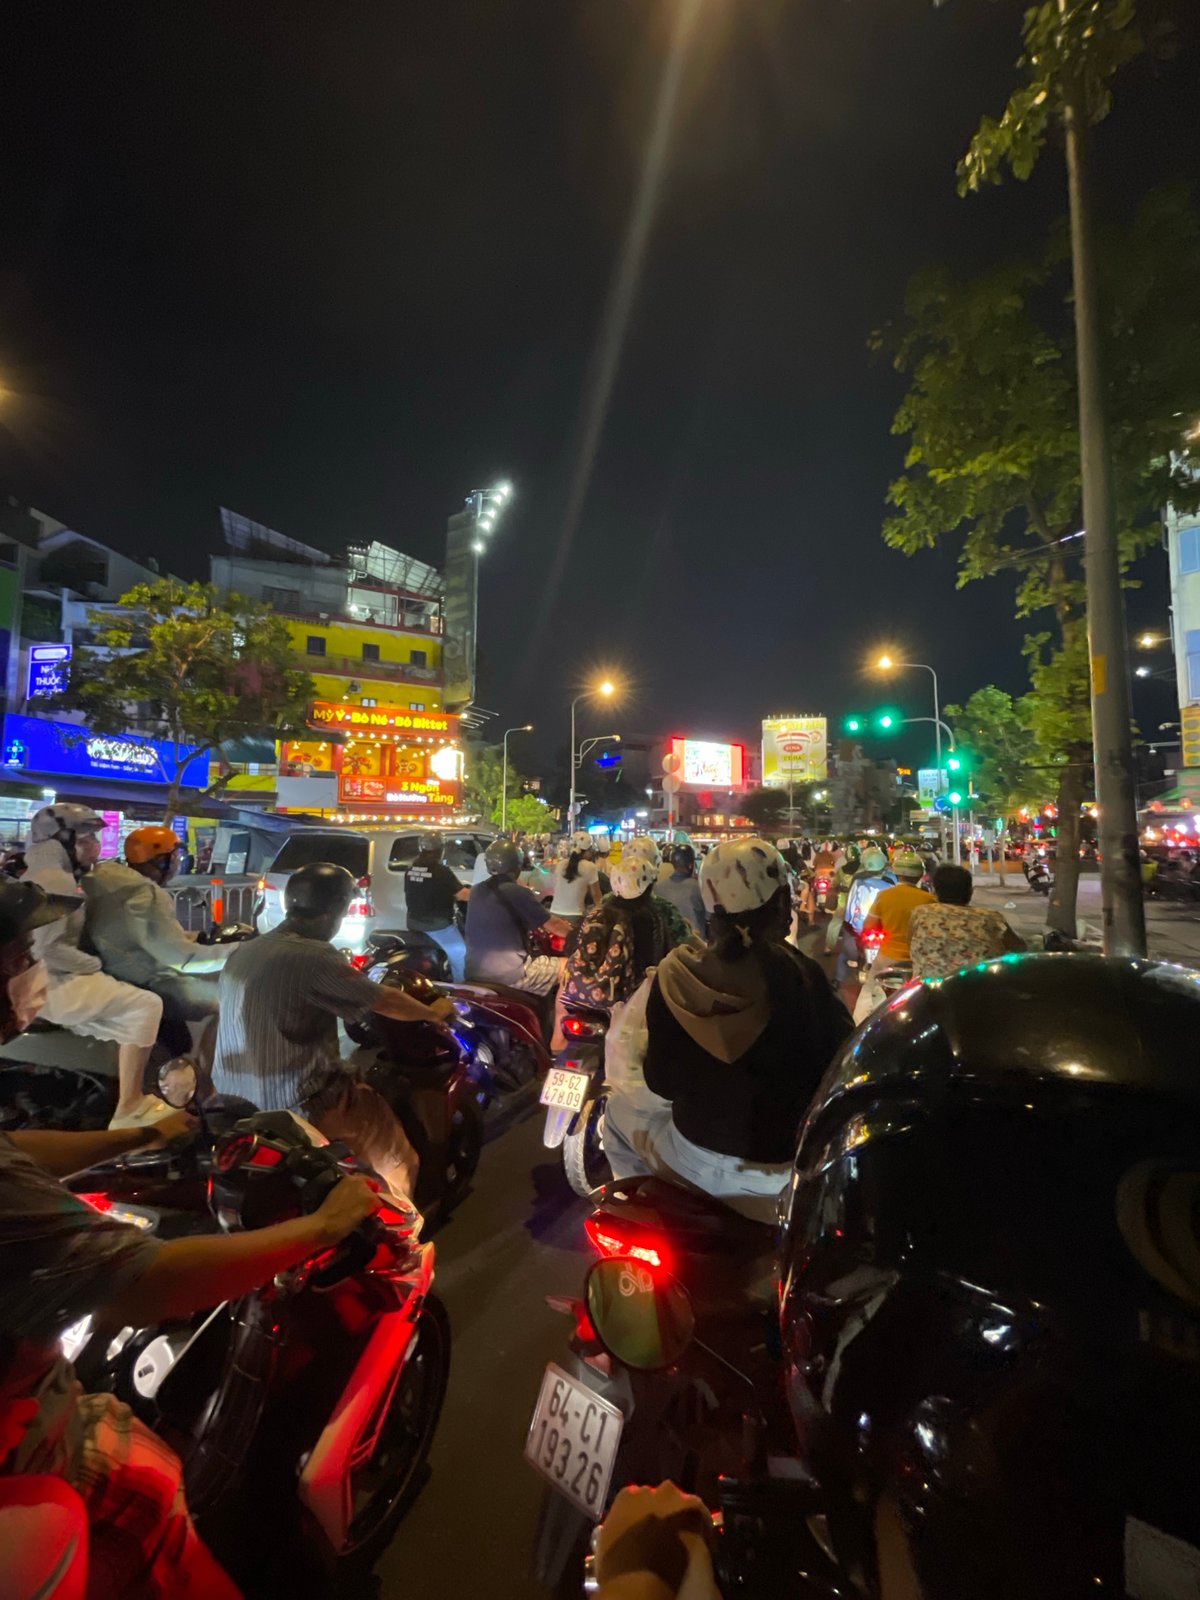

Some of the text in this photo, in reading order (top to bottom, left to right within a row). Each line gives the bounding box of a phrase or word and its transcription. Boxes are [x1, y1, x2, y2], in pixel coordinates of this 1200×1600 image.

[351, 712, 370, 723] Bò
[395, 716, 412, 727] Bò
[401, 781, 409, 791] 3
[552, 1072, 582, 1091] 59-G2
[549, 1379, 609, 1453] 64-C1
[536, 1419, 604, 1505] 193.26
